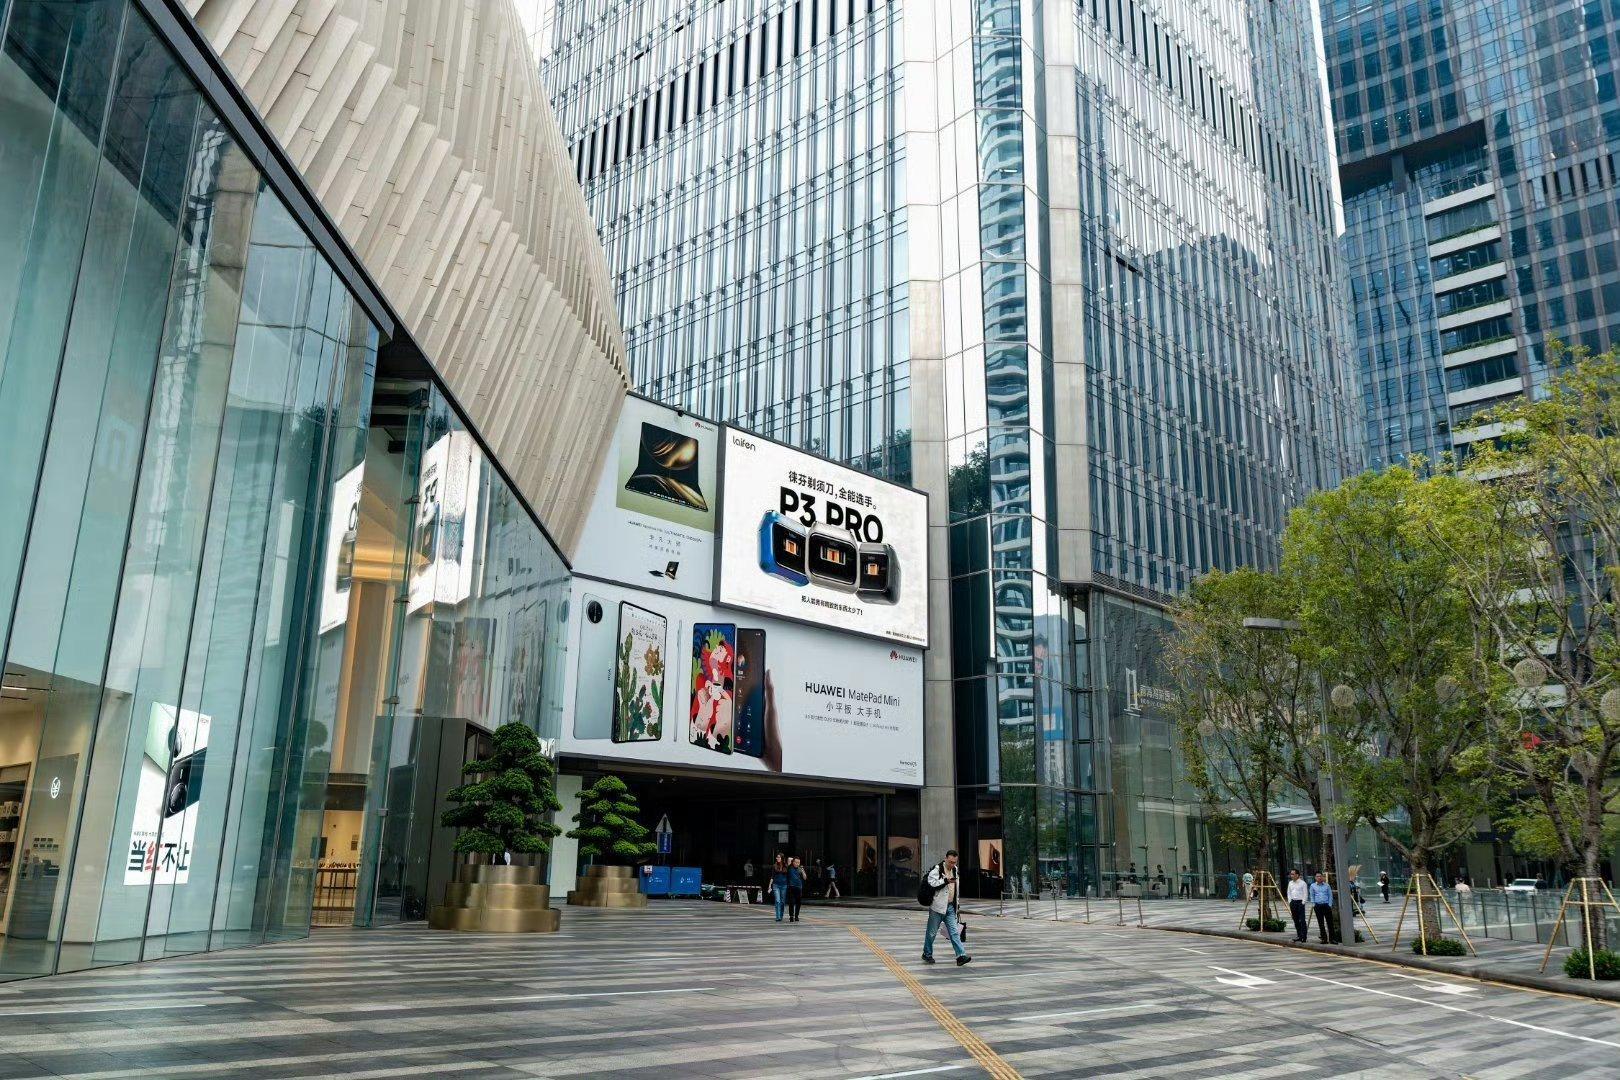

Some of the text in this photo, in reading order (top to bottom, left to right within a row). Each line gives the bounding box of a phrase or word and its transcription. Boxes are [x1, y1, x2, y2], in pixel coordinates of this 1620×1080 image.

[732, 435, 756, 451] laifen
[780, 486, 884, 543] P3 PRO
[805, 681, 901, 707] HUAWEI MatePad Mini
[825, 701, 882, 719] 小平板 大手机
